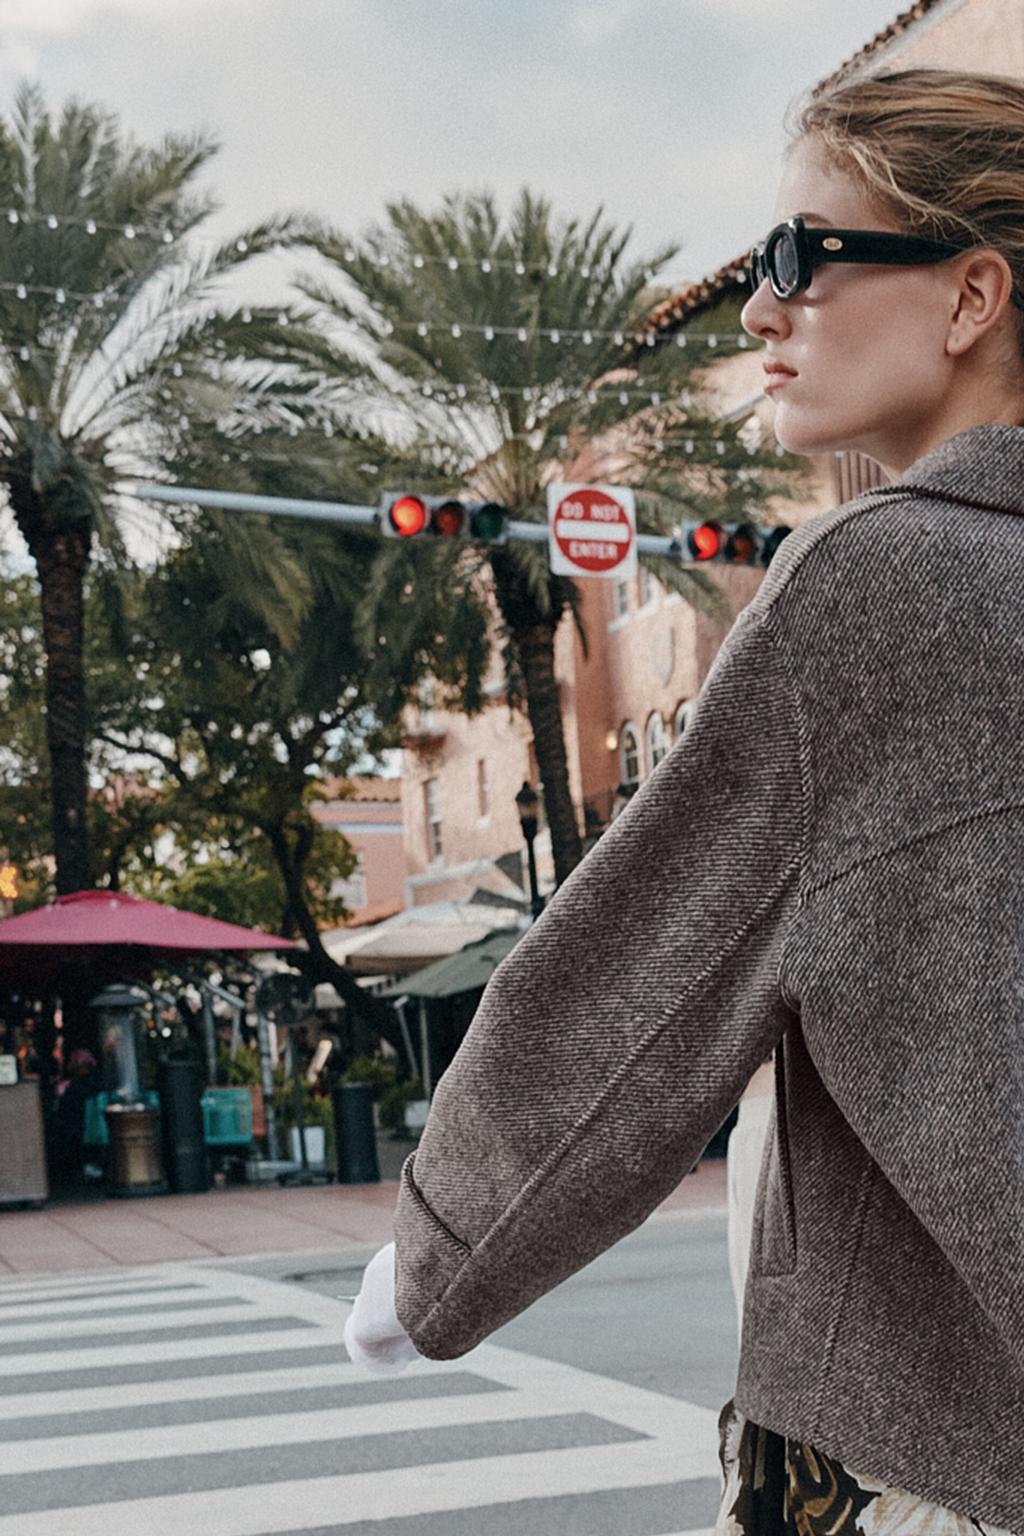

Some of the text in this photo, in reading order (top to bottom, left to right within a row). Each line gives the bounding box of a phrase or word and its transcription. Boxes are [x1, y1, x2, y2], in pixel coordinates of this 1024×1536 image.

[561, 501, 620, 521] DO NOT
[569, 541, 618, 560] ENTER
